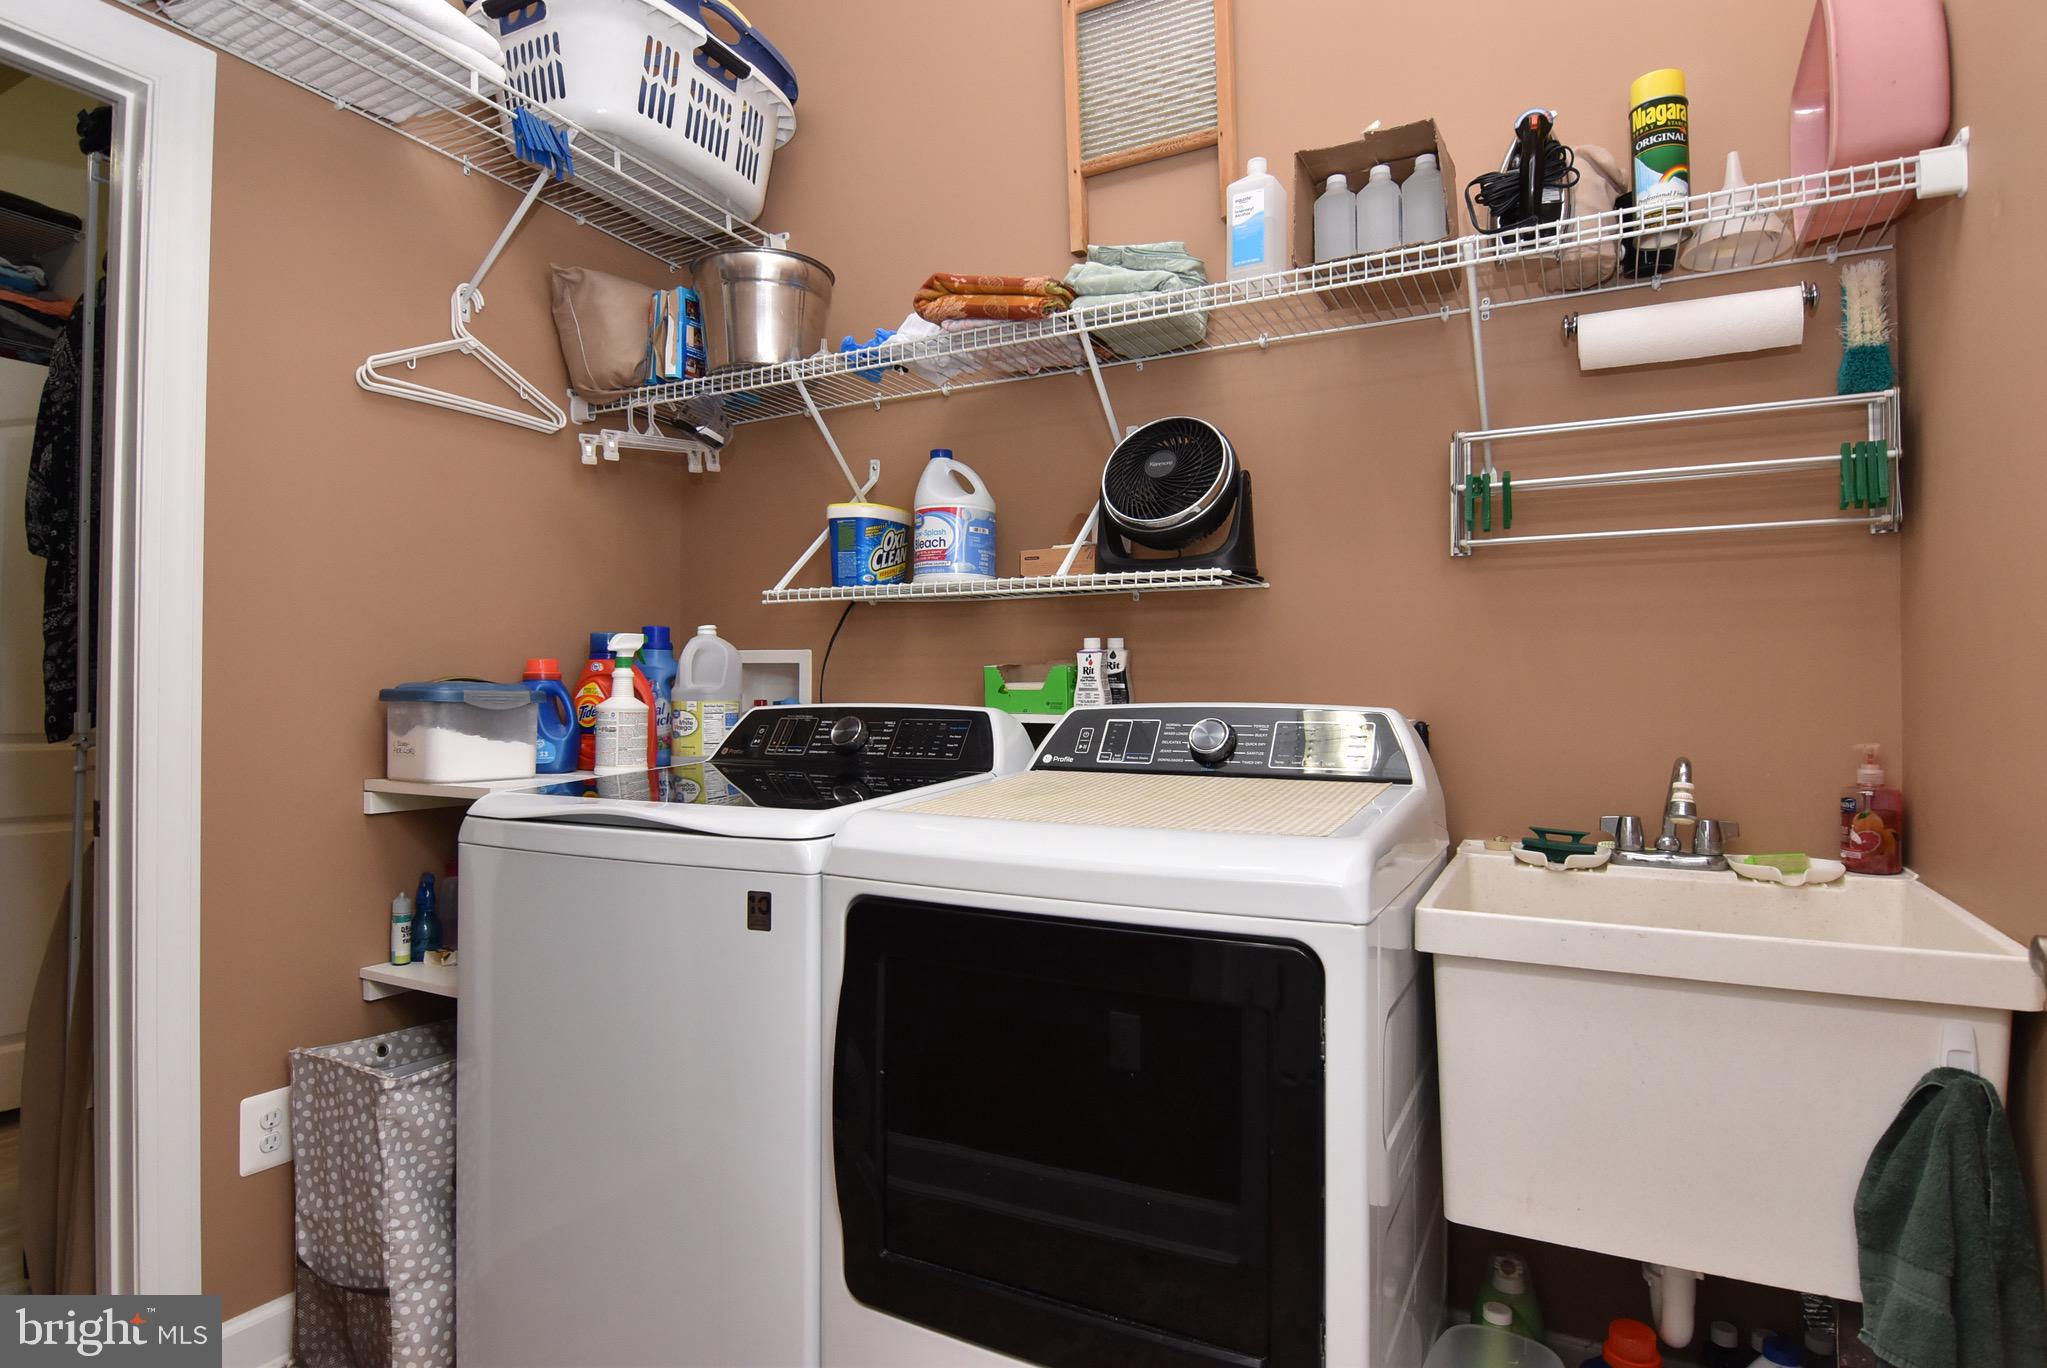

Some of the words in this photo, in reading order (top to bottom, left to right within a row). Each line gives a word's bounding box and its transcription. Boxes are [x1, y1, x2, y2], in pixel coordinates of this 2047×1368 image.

[1632, 103, 1687, 132] Niagara
[1635, 132, 1686, 151] ORIGINAL
[883, 529, 905, 552] OXI
[871, 547, 908, 572] CLEAN
[1083, 667, 1094, 675] Rit
[1107, 662, 1120, 670] Rit
[579, 705, 597, 721] Tide
[655, 702, 665, 715] al
[1052, 755, 1074, 763] Profile
